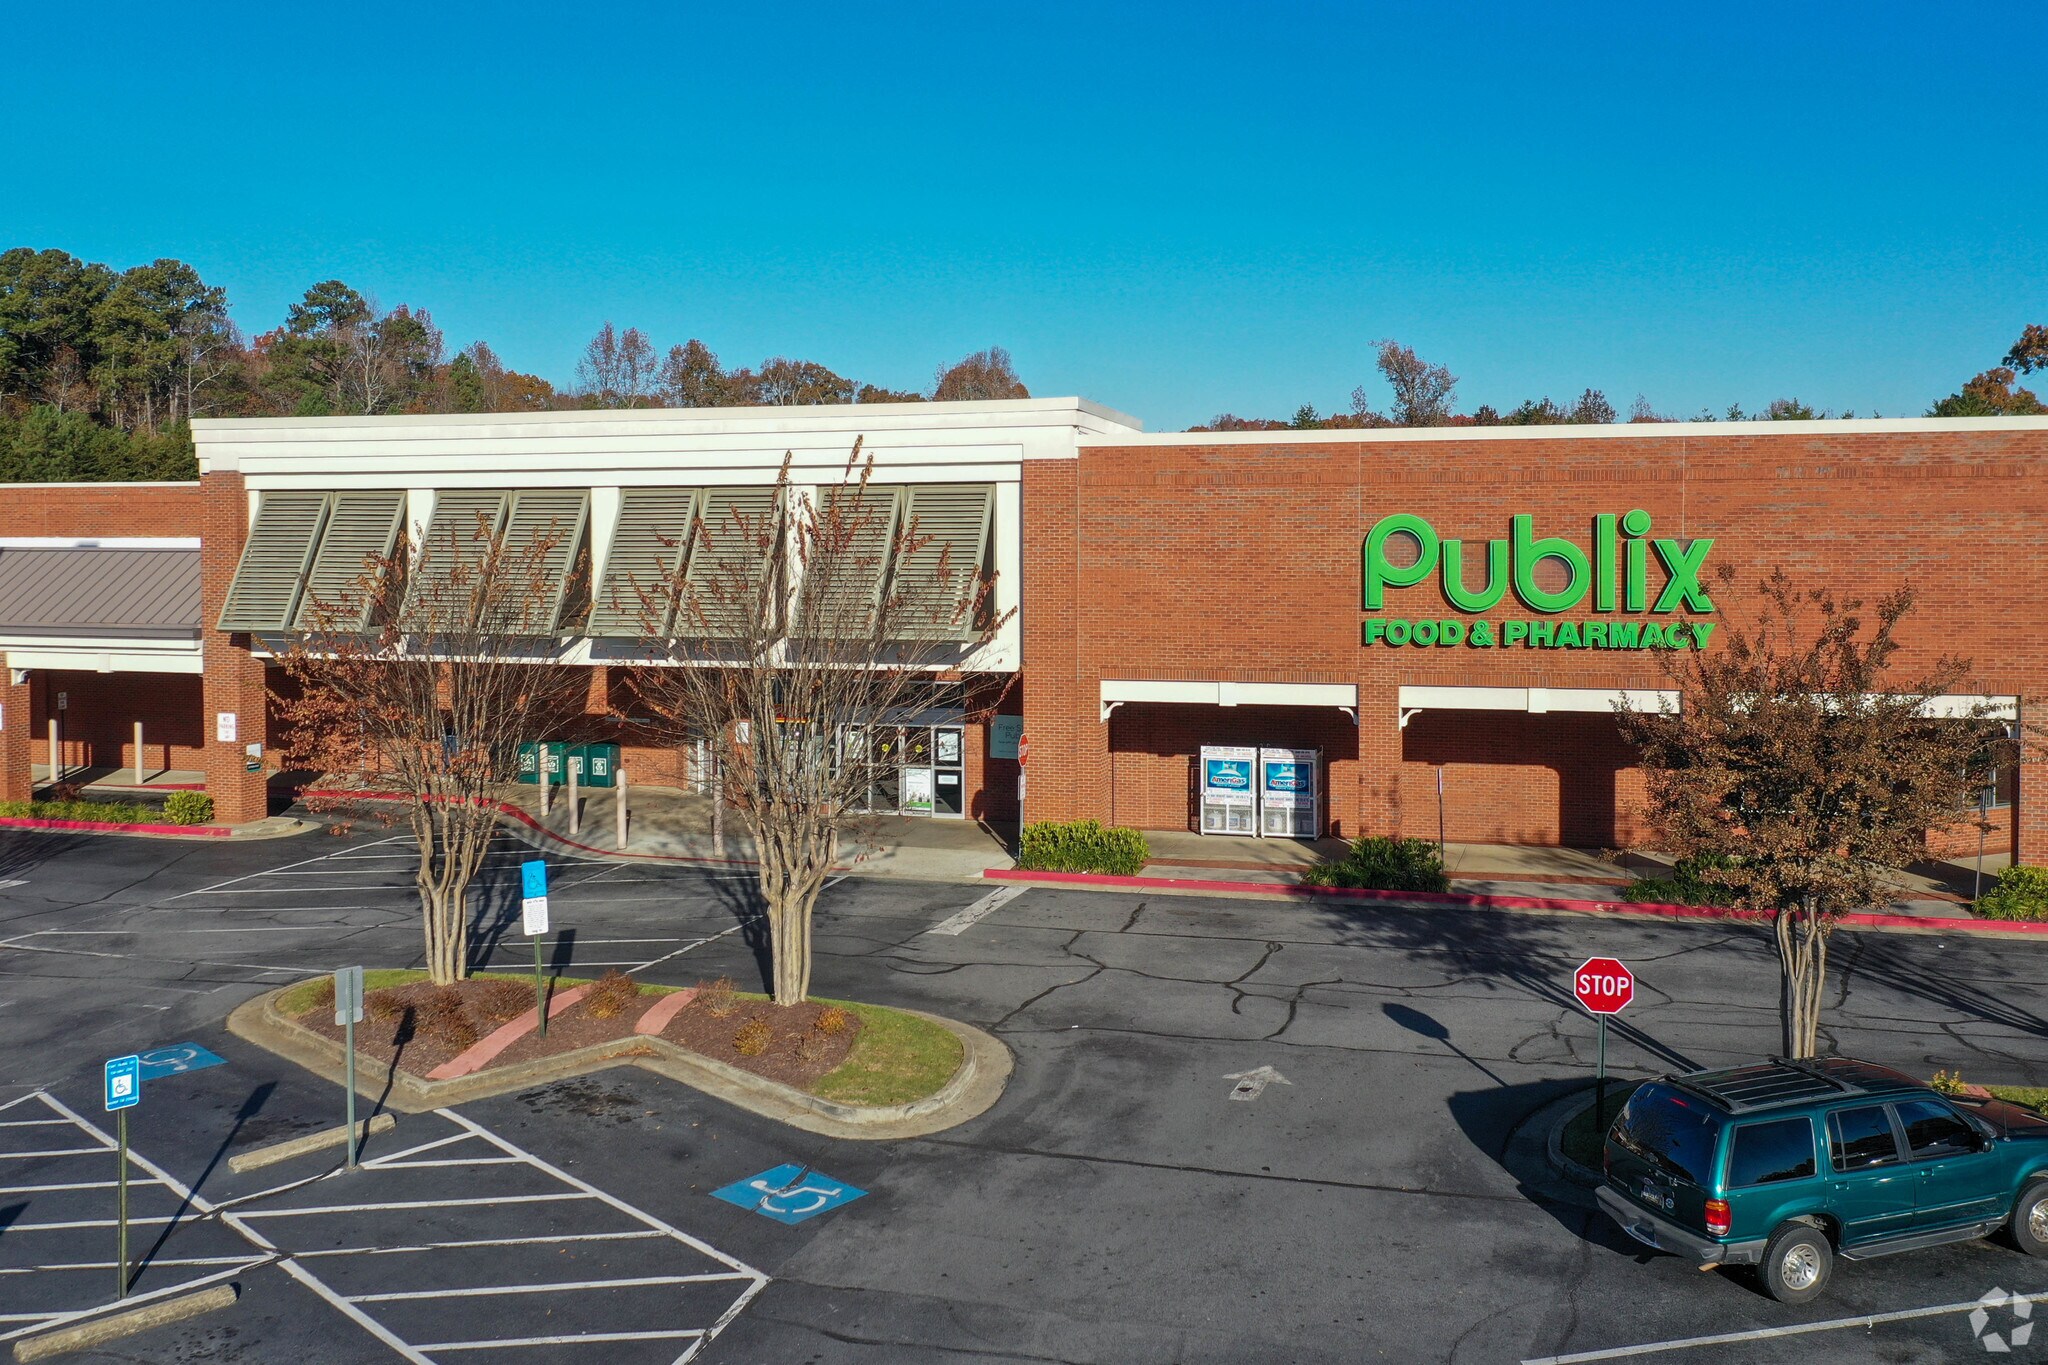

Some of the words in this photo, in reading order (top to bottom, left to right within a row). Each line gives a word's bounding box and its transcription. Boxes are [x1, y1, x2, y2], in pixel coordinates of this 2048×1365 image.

[1363, 509, 1715, 613] Publix
[1364, 618, 1465, 647] FOOD
[1469, 620, 1495, 647] &
[1504, 620, 1716, 650] PHARMACY
[1270, 779, 1304, 787] AmeriGas
[1578, 974, 1629, 996] STOP
